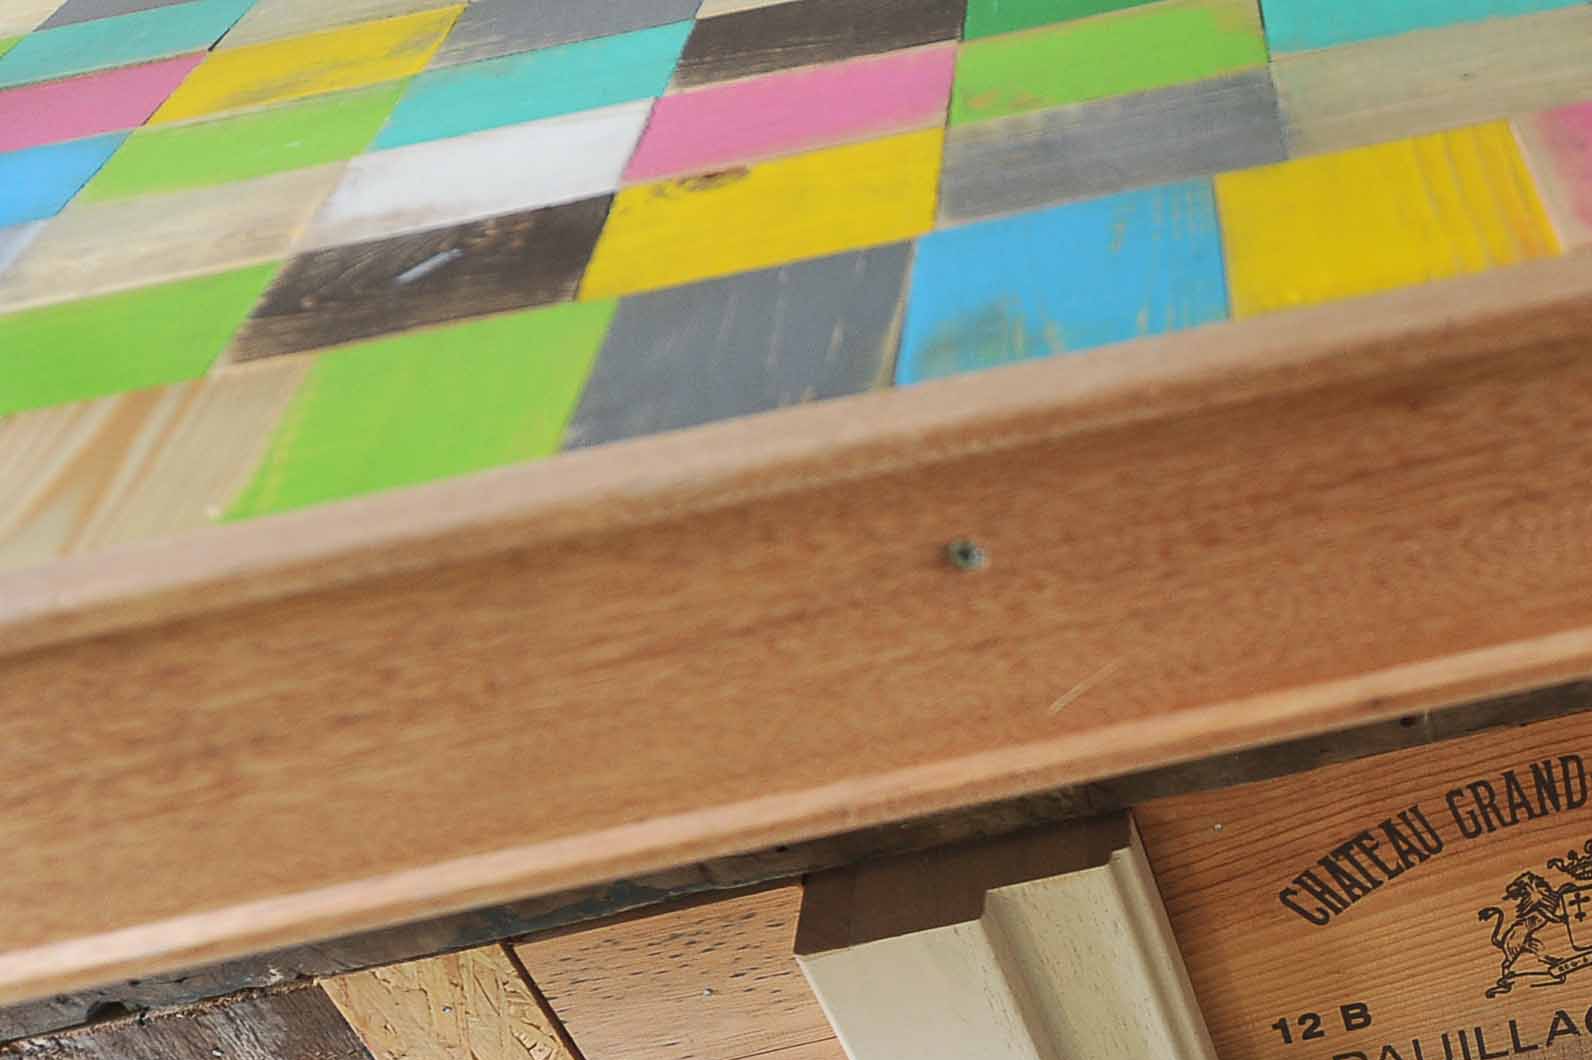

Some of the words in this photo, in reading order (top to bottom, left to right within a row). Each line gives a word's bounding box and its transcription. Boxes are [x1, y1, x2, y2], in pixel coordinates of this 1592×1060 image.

[1279, 806, 1444, 926] CHATEAU
[1271, 1011, 1326, 1045] 12
[1341, 1002, 1373, 1031] B
